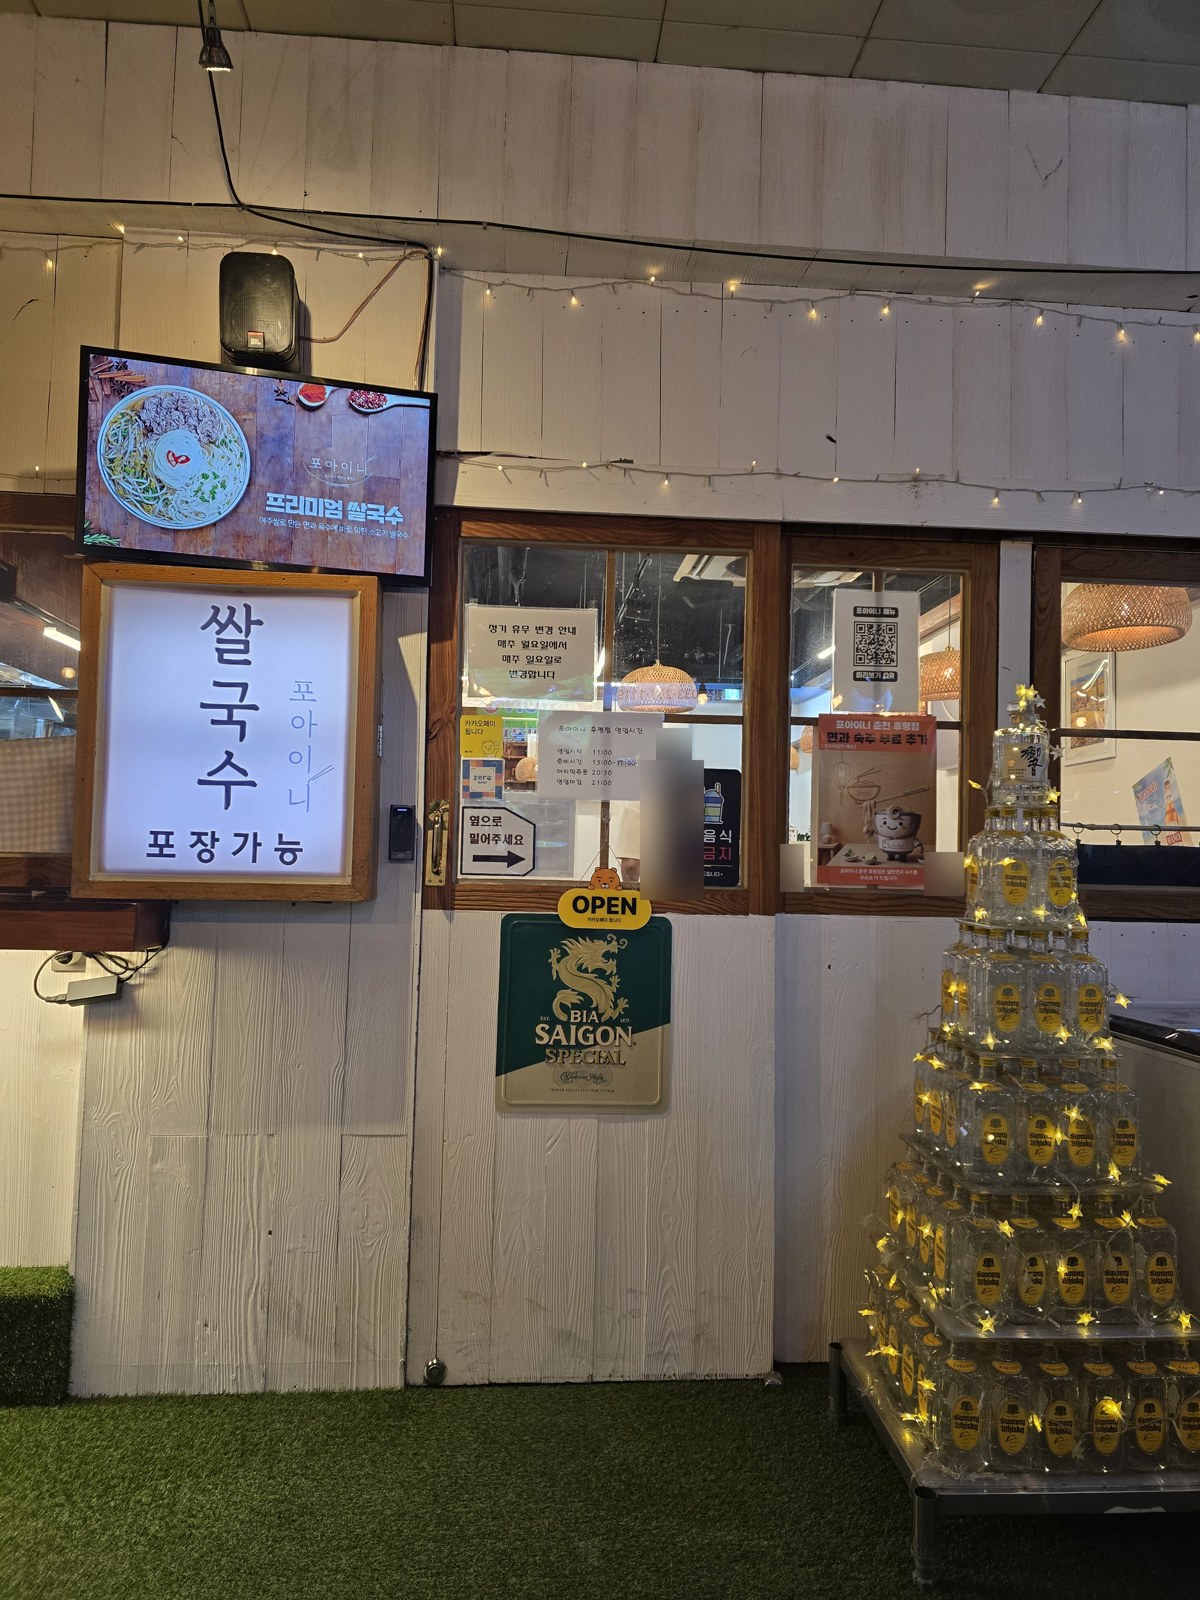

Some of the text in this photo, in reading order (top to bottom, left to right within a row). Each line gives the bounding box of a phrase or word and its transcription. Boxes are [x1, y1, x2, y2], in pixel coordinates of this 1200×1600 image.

[309, 456, 369, 475] 포아이니
[266, 492, 404, 526] 프리미엄 쌀국수
[856, 607, 882, 615] 포아이니
[488, 624, 577, 636] 정기 휴무 변경 안내
[497, 640, 568, 650] 매주 월요일에서
[502, 655, 562, 665] 매주 일요일로
[509, 669, 556, 680] 변경합니다
[197, 602, 264, 811] 쌀국수
[465, 720, 496, 728] 카카오페이
[836, 720, 920, 732] 포아이니 춘천 후평점
[465, 728, 484, 736] 됩니다
[591, 726, 612, 734] 후평점
[615, 727, 643, 735] 영업시간
[827, 731, 929, 745] 면과 숙주 무료 추가
[288, 680, 320, 813] 포아이니
[557, 758, 582, 766] 준비시간
[557, 768, 588, 776] 마지막주문
[469, 815, 503, 828] 옆으로
[469, 833, 524, 846] 밀어주세요
[572, 895, 637, 915] OPEN
[570, 1010, 600, 1023] BIA
[535, 1023, 633, 1048] SAIGON
[545, 1048, 627, 1066] SPECIAL
[1030, 1139, 1052, 1148] Whisky
[1071, 1140, 1093, 1148] Whisky
[976, 1271, 1000, 1279] Suntory
[977, 1278, 999, 1286] Whisky
[1062, 1278, 1085, 1286] Whisky
[1105, 1277, 1129, 1286] Whisky
[1151, 1277, 1173, 1285] Whisky
[953, 1414, 979, 1422] Suntory
[1000, 1418, 1025, 1426] Suntory
[954, 1421, 978, 1431] Whisky
[1000, 1425, 1025, 1435] Whisky
